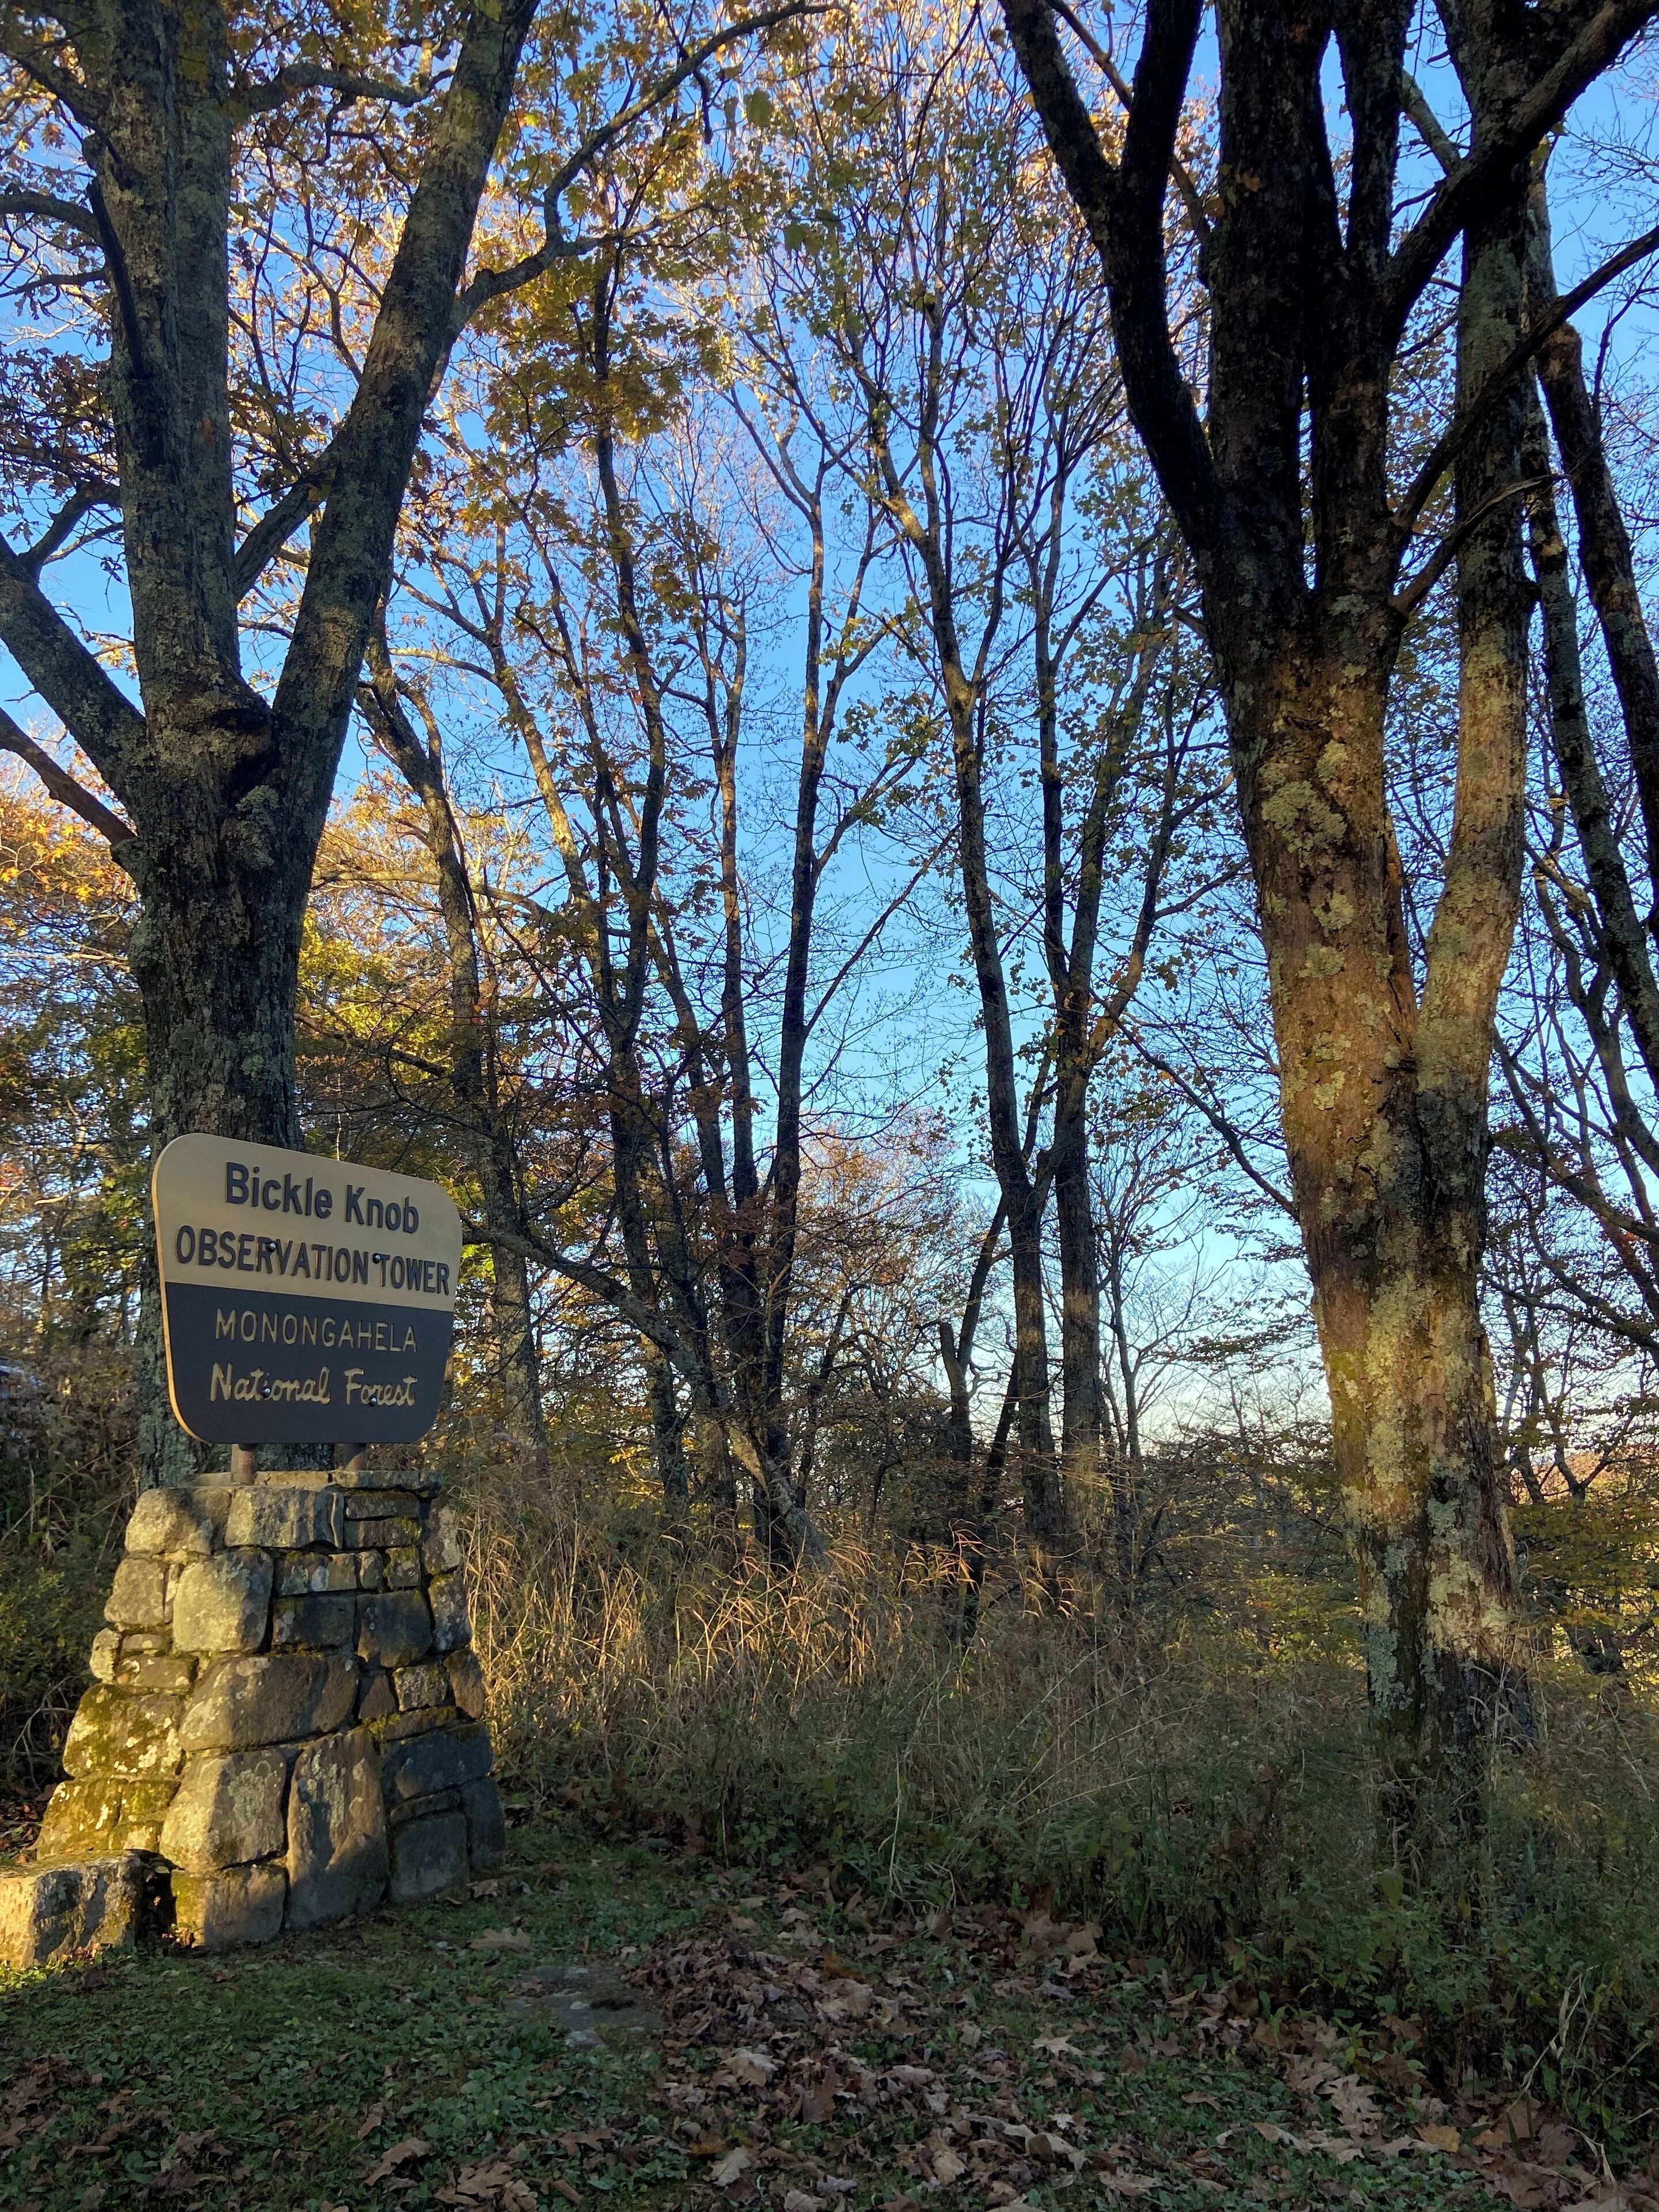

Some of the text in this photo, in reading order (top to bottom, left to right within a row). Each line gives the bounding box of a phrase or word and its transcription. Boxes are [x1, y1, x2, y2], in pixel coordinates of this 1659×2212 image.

[226, 1161, 419, 1234] Bickle Knob
[176, 1225, 450, 1296] OBSERVATION TOWER
[215, 1308, 417, 1353] MONONGAHELA
[210, 1362, 418, 1407] National Forest
